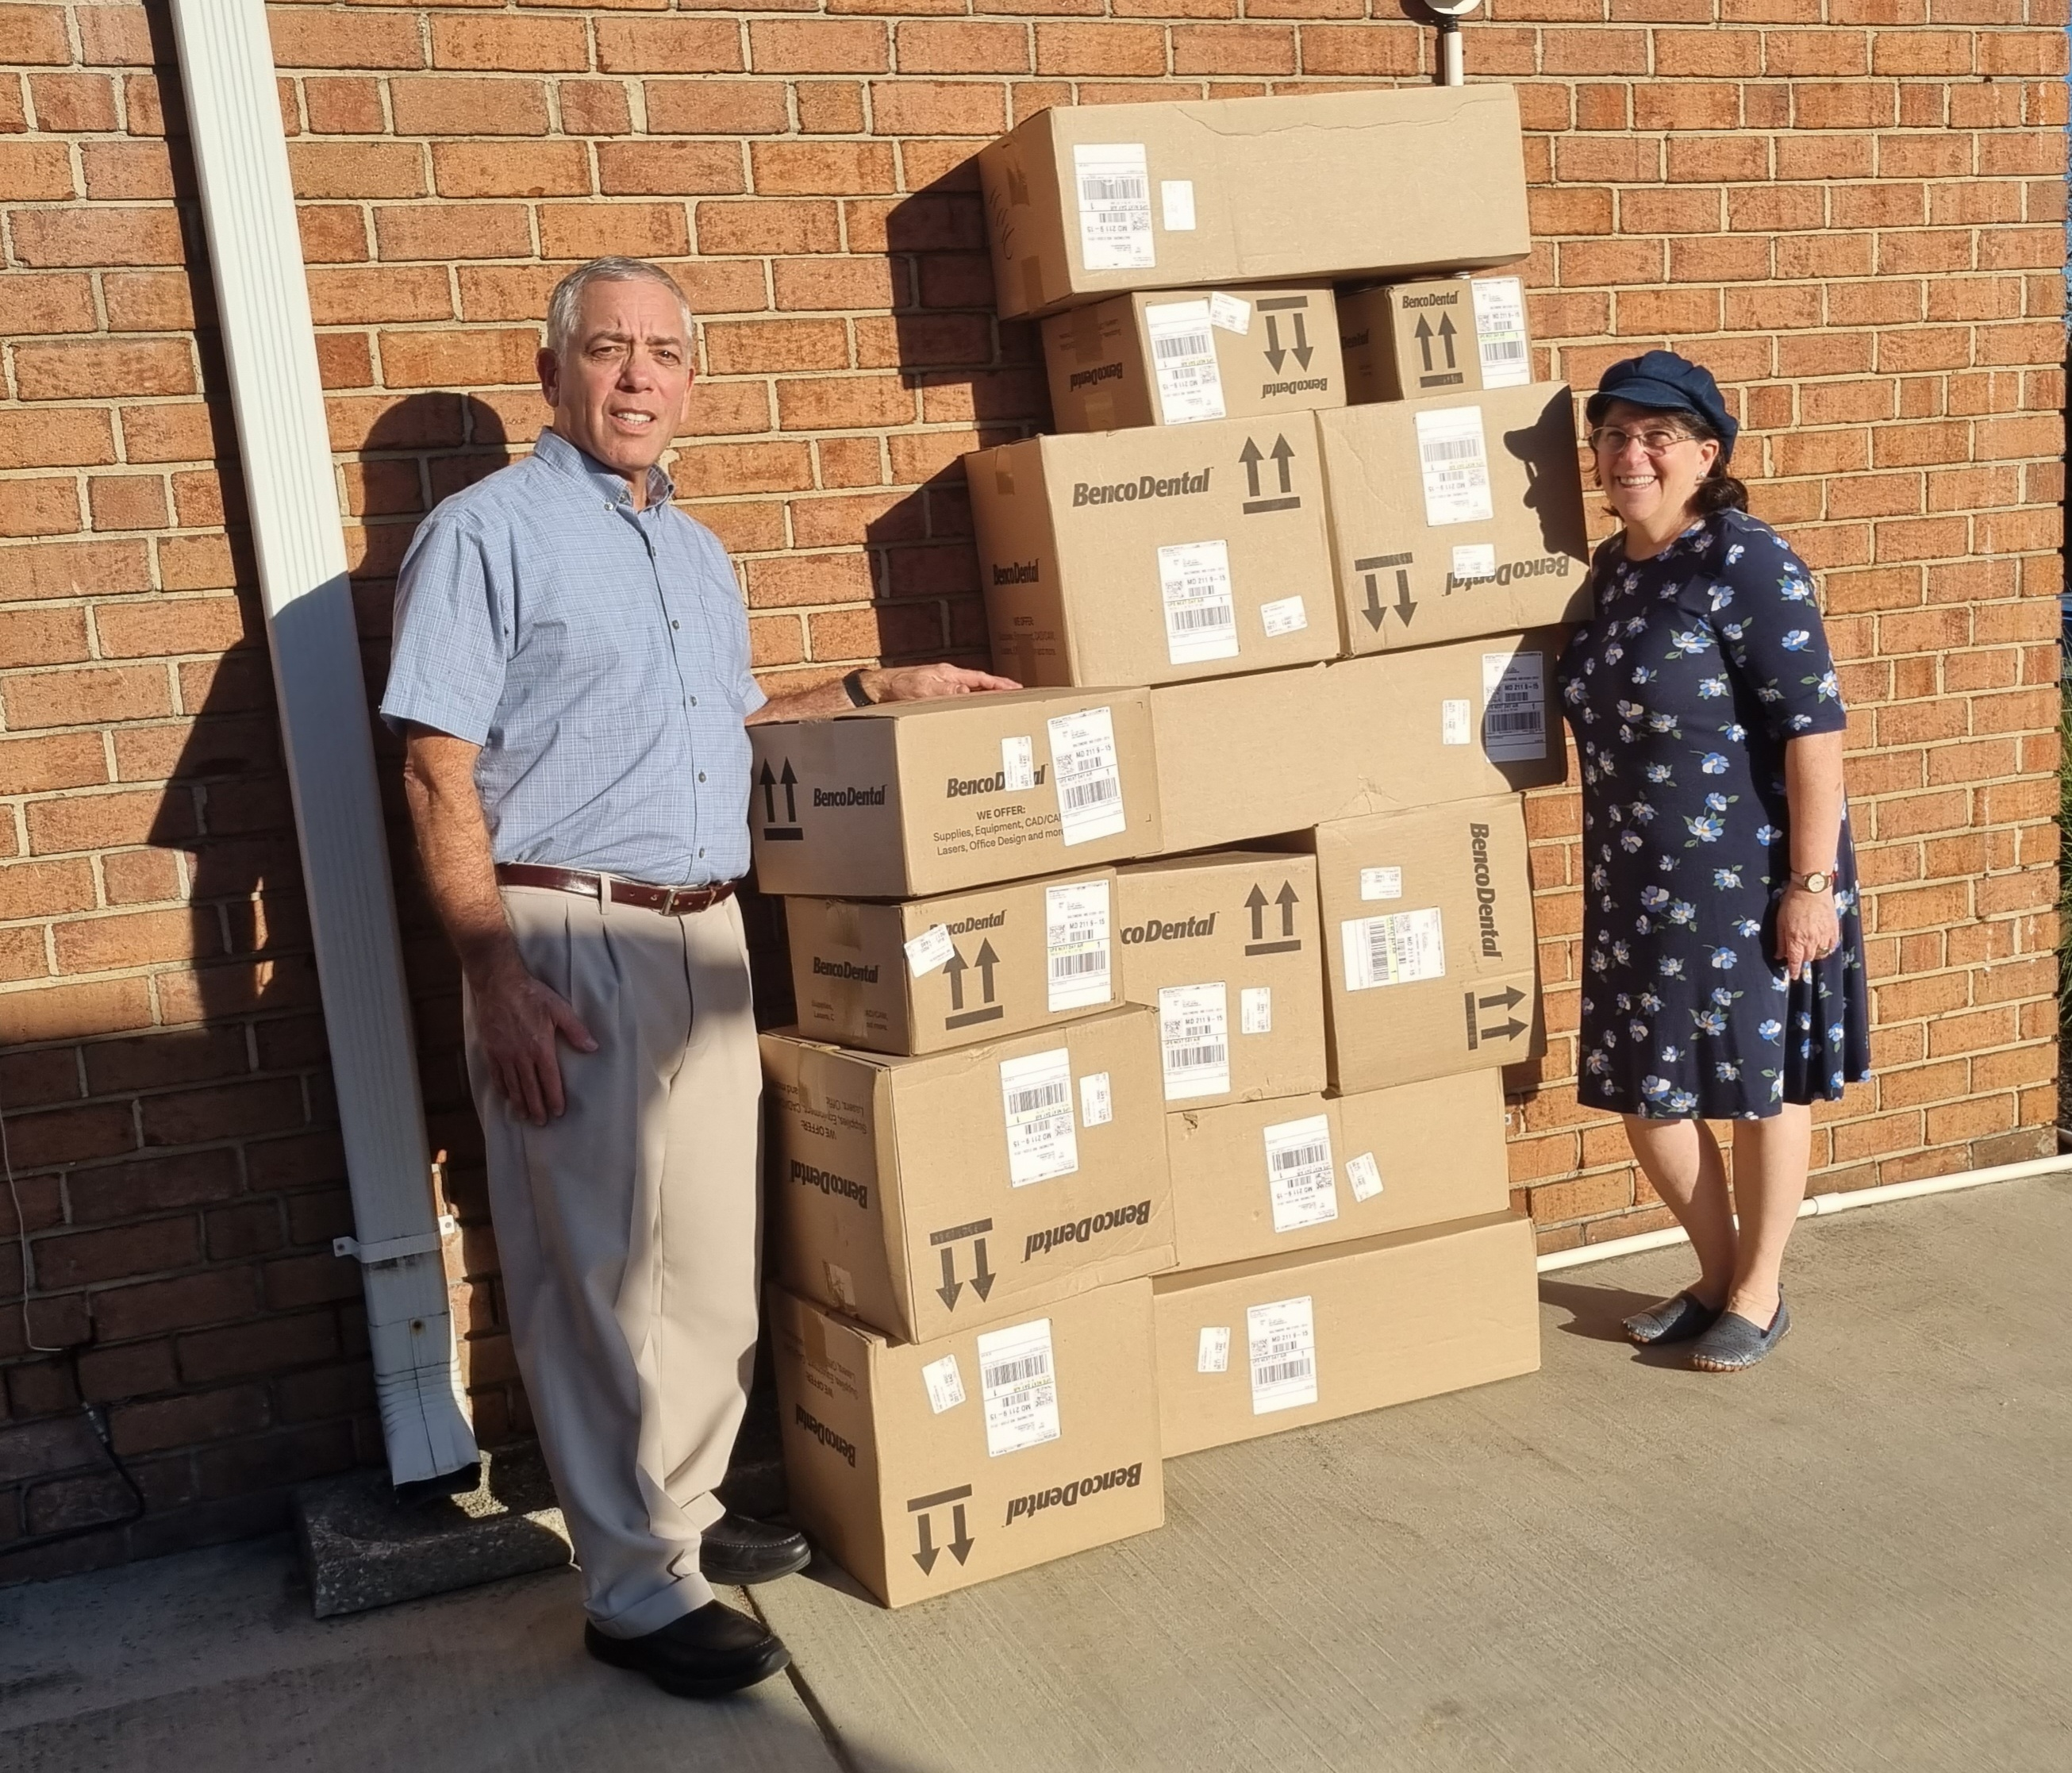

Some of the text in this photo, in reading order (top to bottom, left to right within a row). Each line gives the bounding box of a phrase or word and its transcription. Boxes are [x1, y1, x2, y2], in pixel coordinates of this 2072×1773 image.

[1072, 467, 1214, 507] BencoDental
[976, 805, 1026, 821] WE OFFER:
[933, 813, 1061, 842] Supplies, Equipment, CAD/CA
[937, 843, 968, 856] Lasers,
[970, 838, 996, 851] Office
[998, 835, 1027, 846] Design
[1028, 830, 1044, 840] and
[1021, 1402, 1030, 1411] MD
